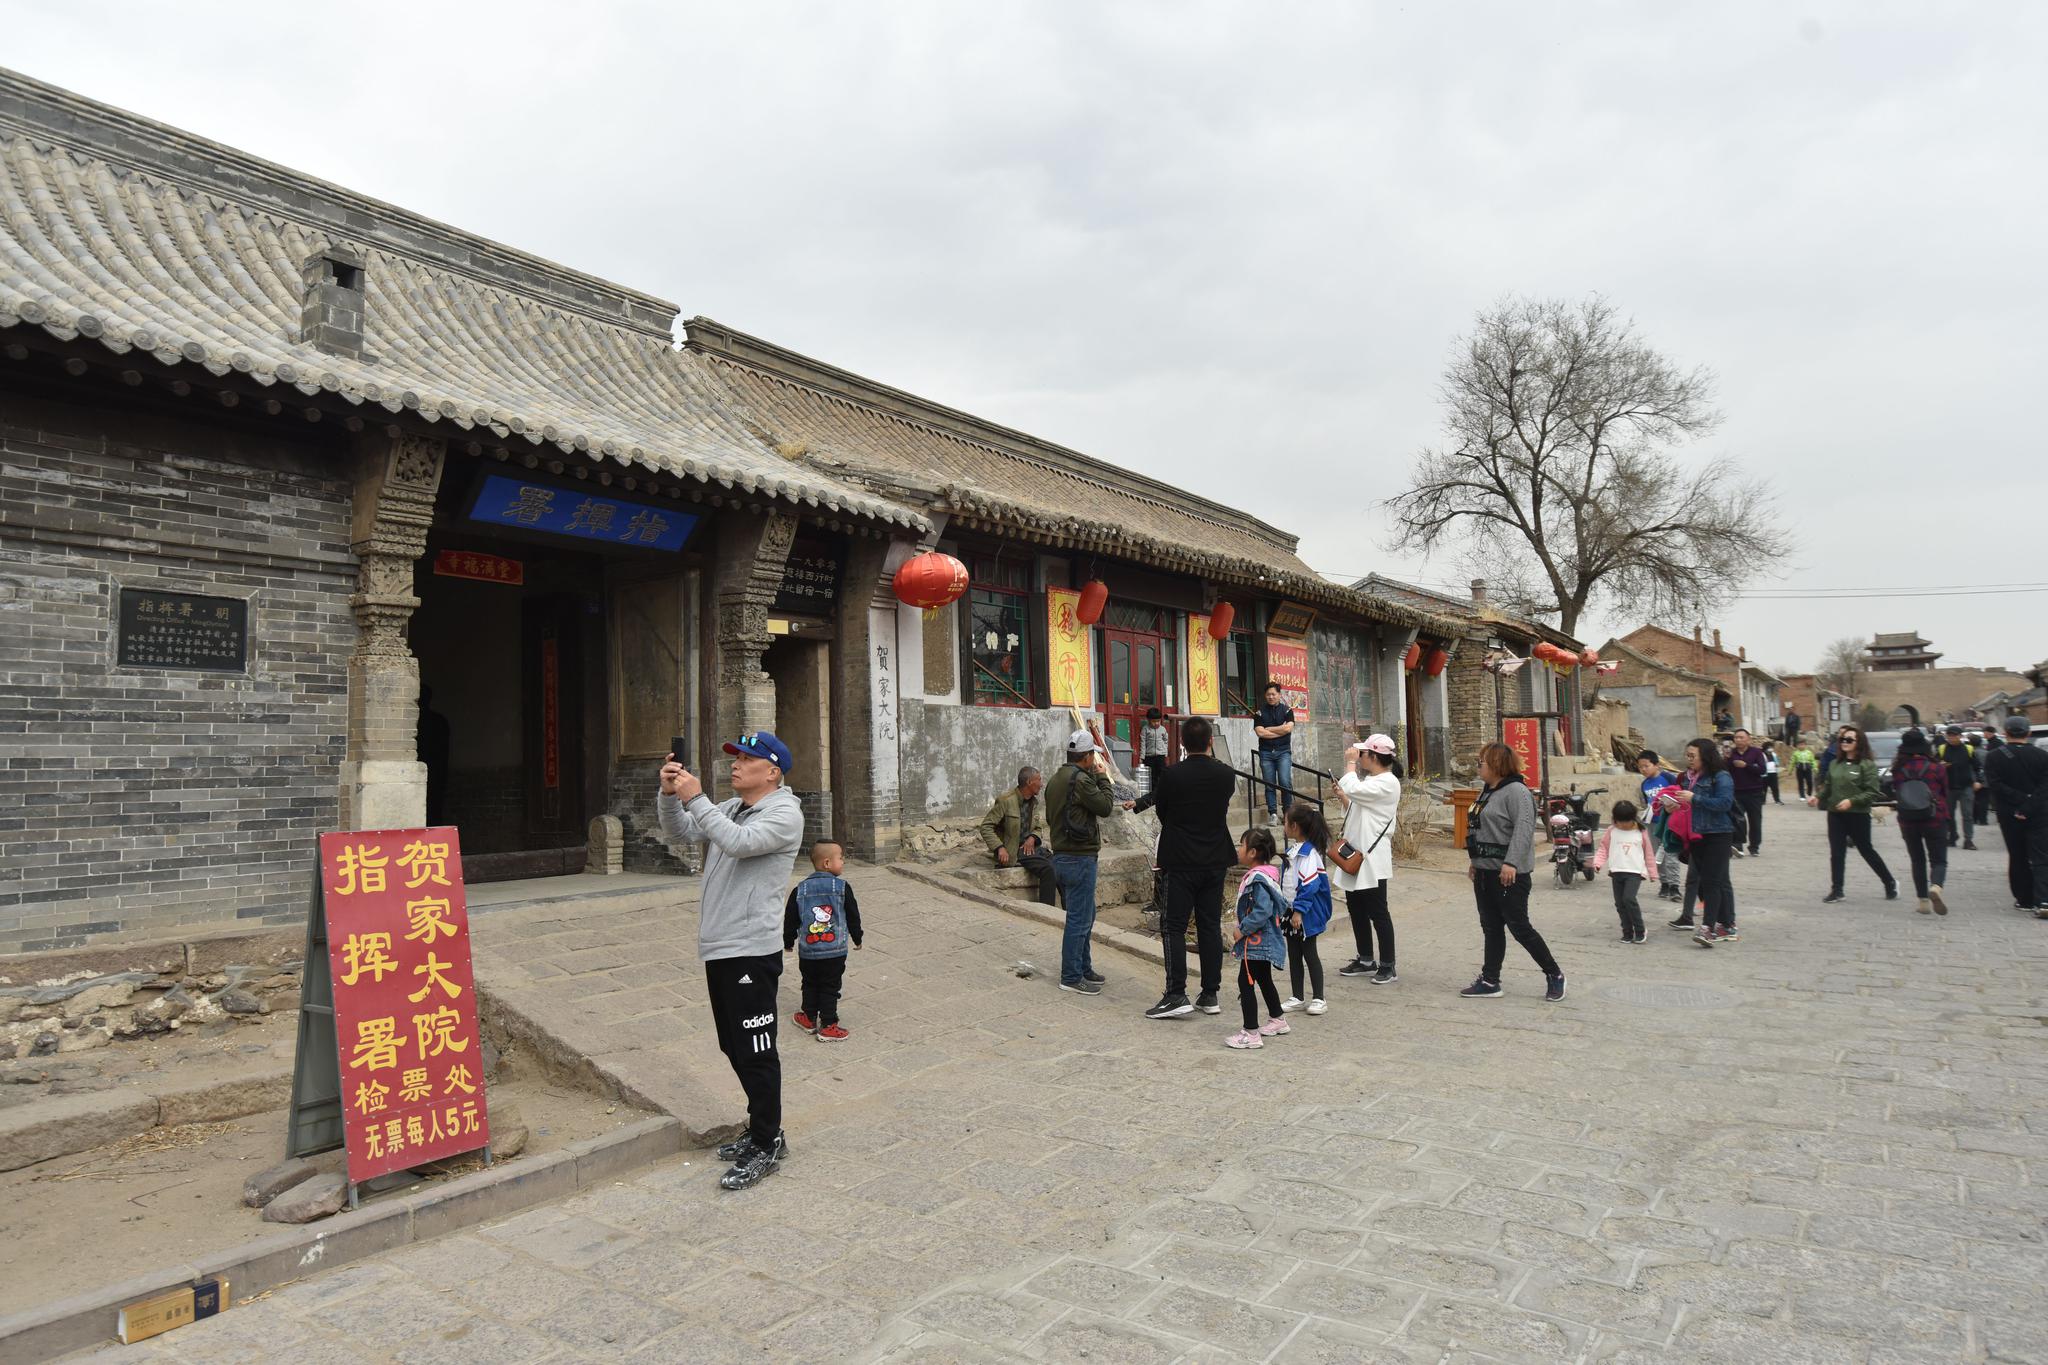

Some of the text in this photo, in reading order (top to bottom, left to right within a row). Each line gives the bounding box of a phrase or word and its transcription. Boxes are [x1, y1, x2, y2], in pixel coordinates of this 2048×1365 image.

[1057, 603, 1077, 684] 超市
[334, 844, 408, 1072] 指挥署
[395, 839, 470, 1061] 贺家大院
[742, 1013, 774, 1029] adidas
[354, 1064, 477, 1115] 检票处
[366, 1100, 480, 1160] 无票每人5元
